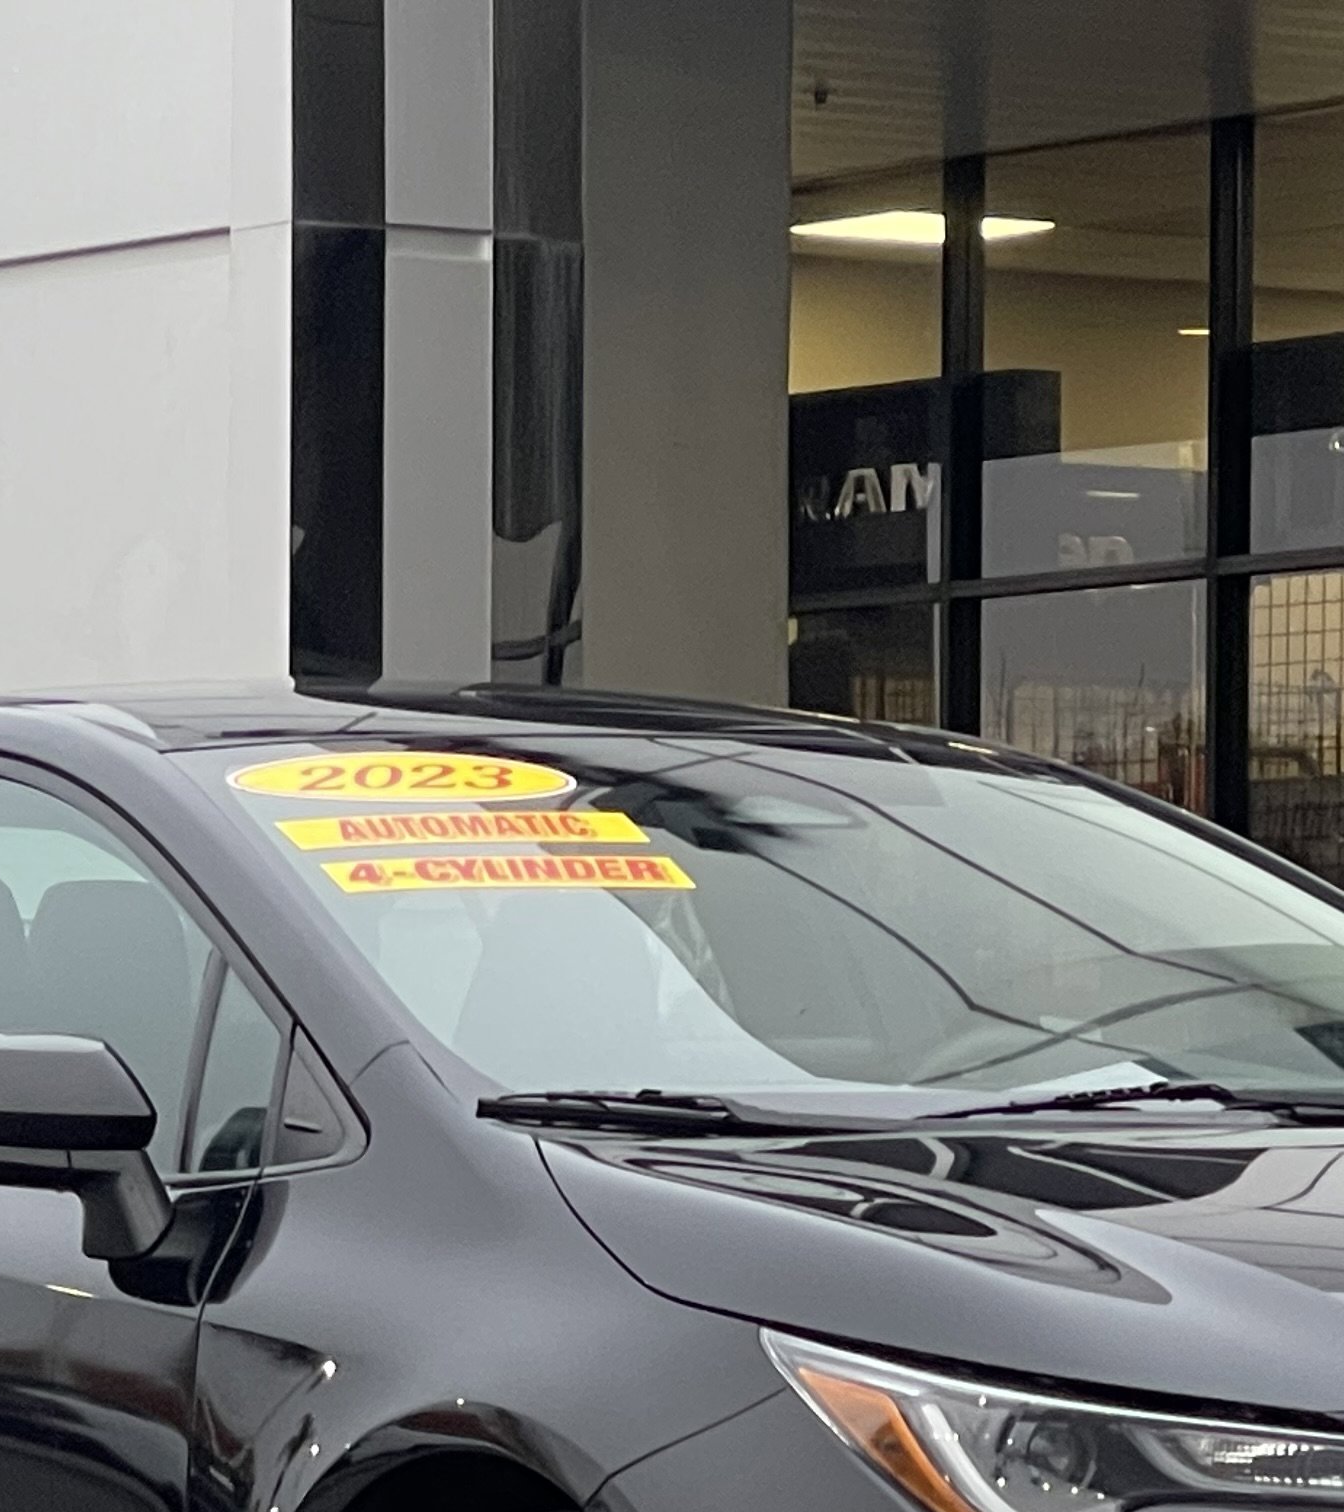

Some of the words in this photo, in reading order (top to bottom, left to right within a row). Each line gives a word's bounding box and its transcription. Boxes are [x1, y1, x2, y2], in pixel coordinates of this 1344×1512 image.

[299, 763, 514, 791] 2023
[338, 813, 594, 842] AUTOMATIC
[348, 857, 670, 887] 4-CYLINDER
